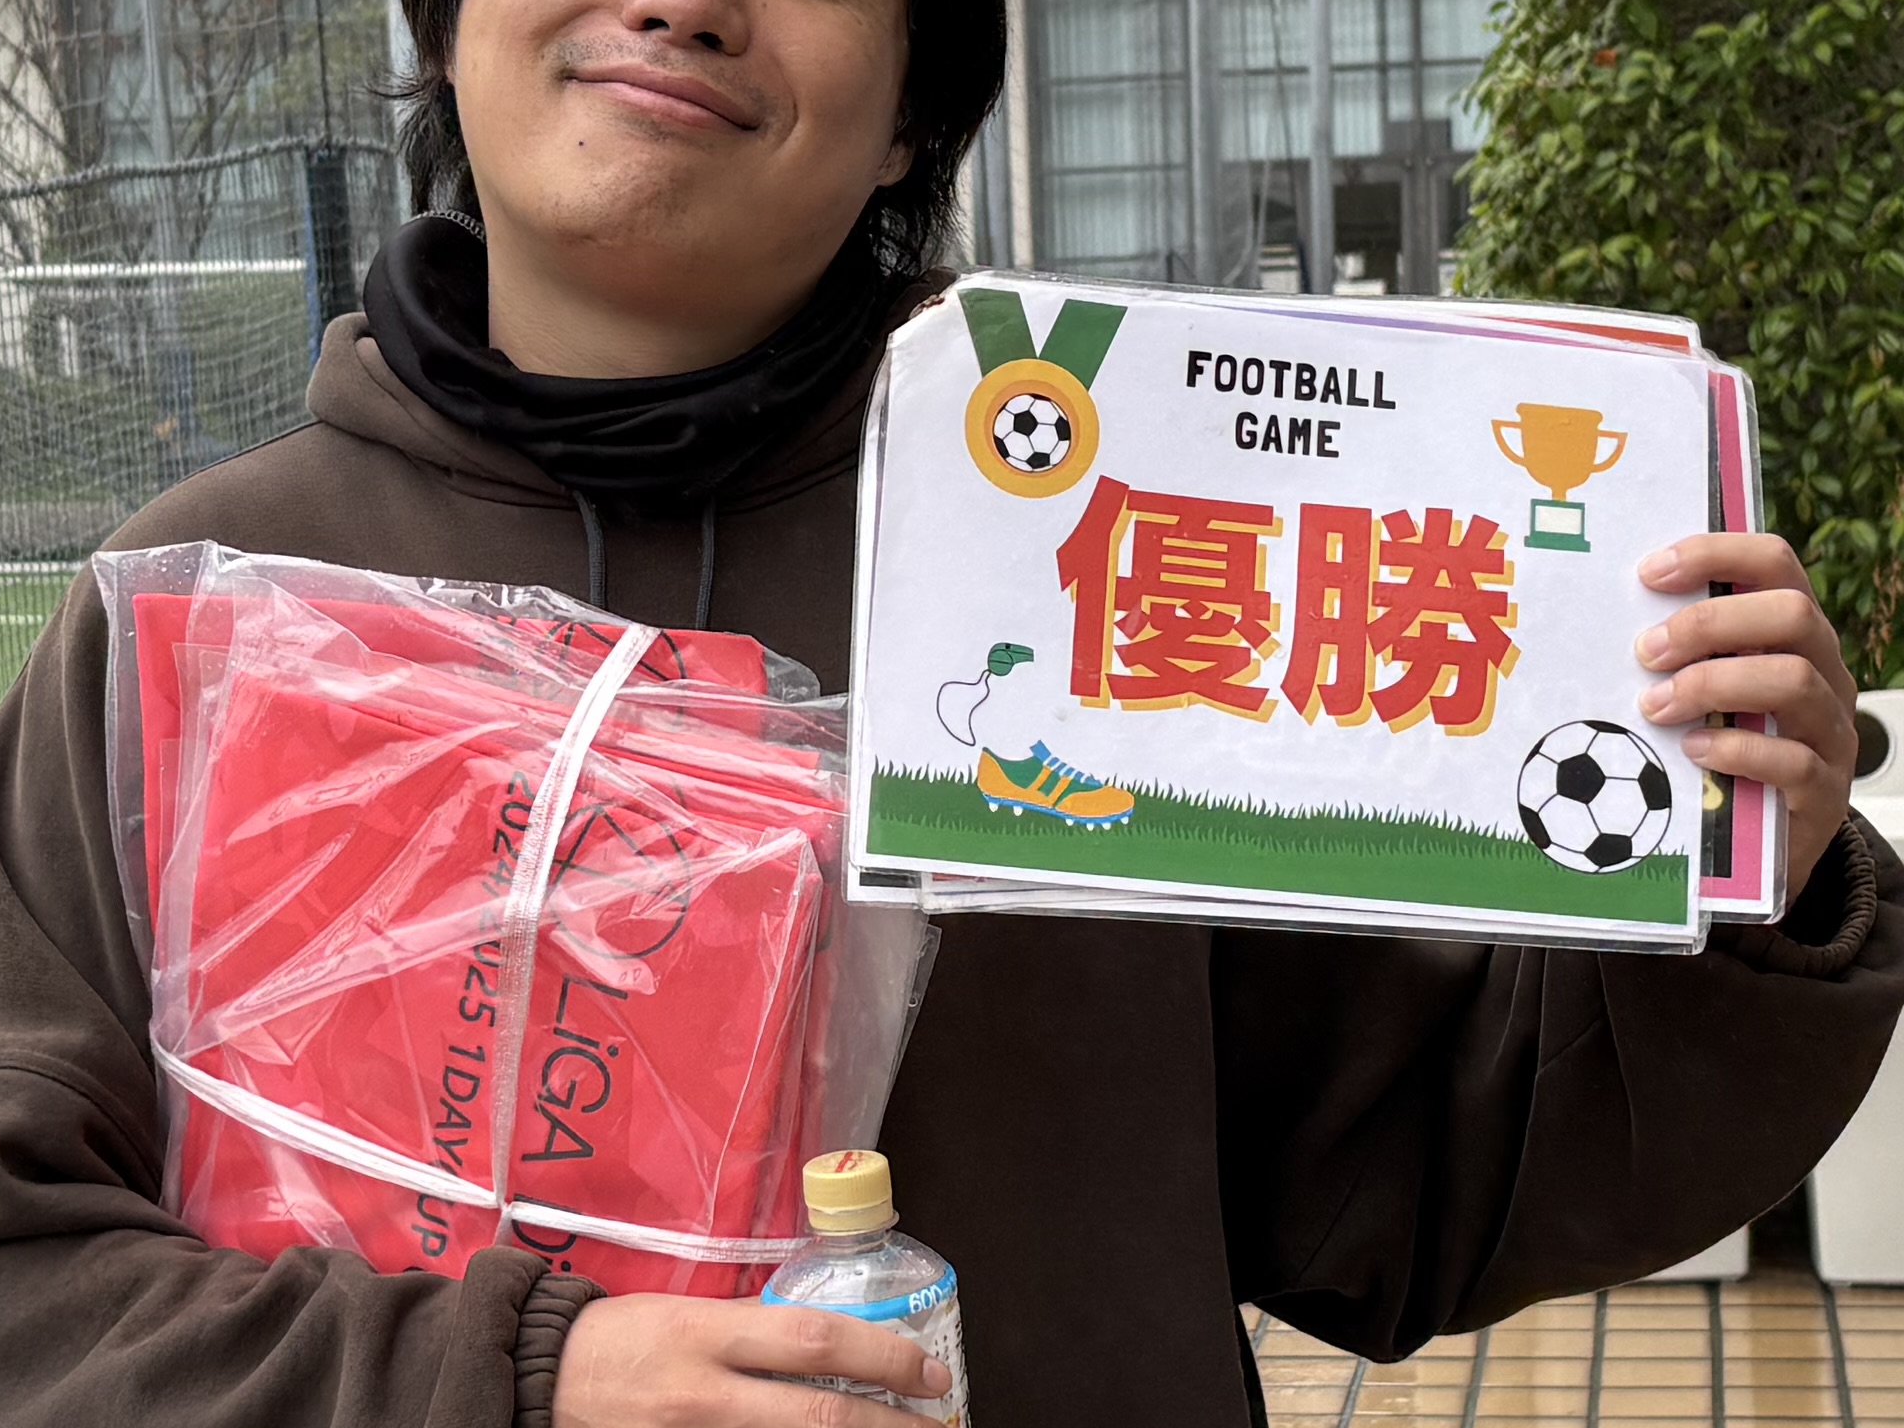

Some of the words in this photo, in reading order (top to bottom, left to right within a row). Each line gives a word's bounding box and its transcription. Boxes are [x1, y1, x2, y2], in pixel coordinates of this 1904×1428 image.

[1185, 349, 1397, 411] FOOTBALL
[1234, 410, 1342, 459] GAME
[1055, 474, 1522, 738] 優勝
[410, 1045, 487, 1258] 1DAYUP
[521, 976, 628, 1162] LiGA
